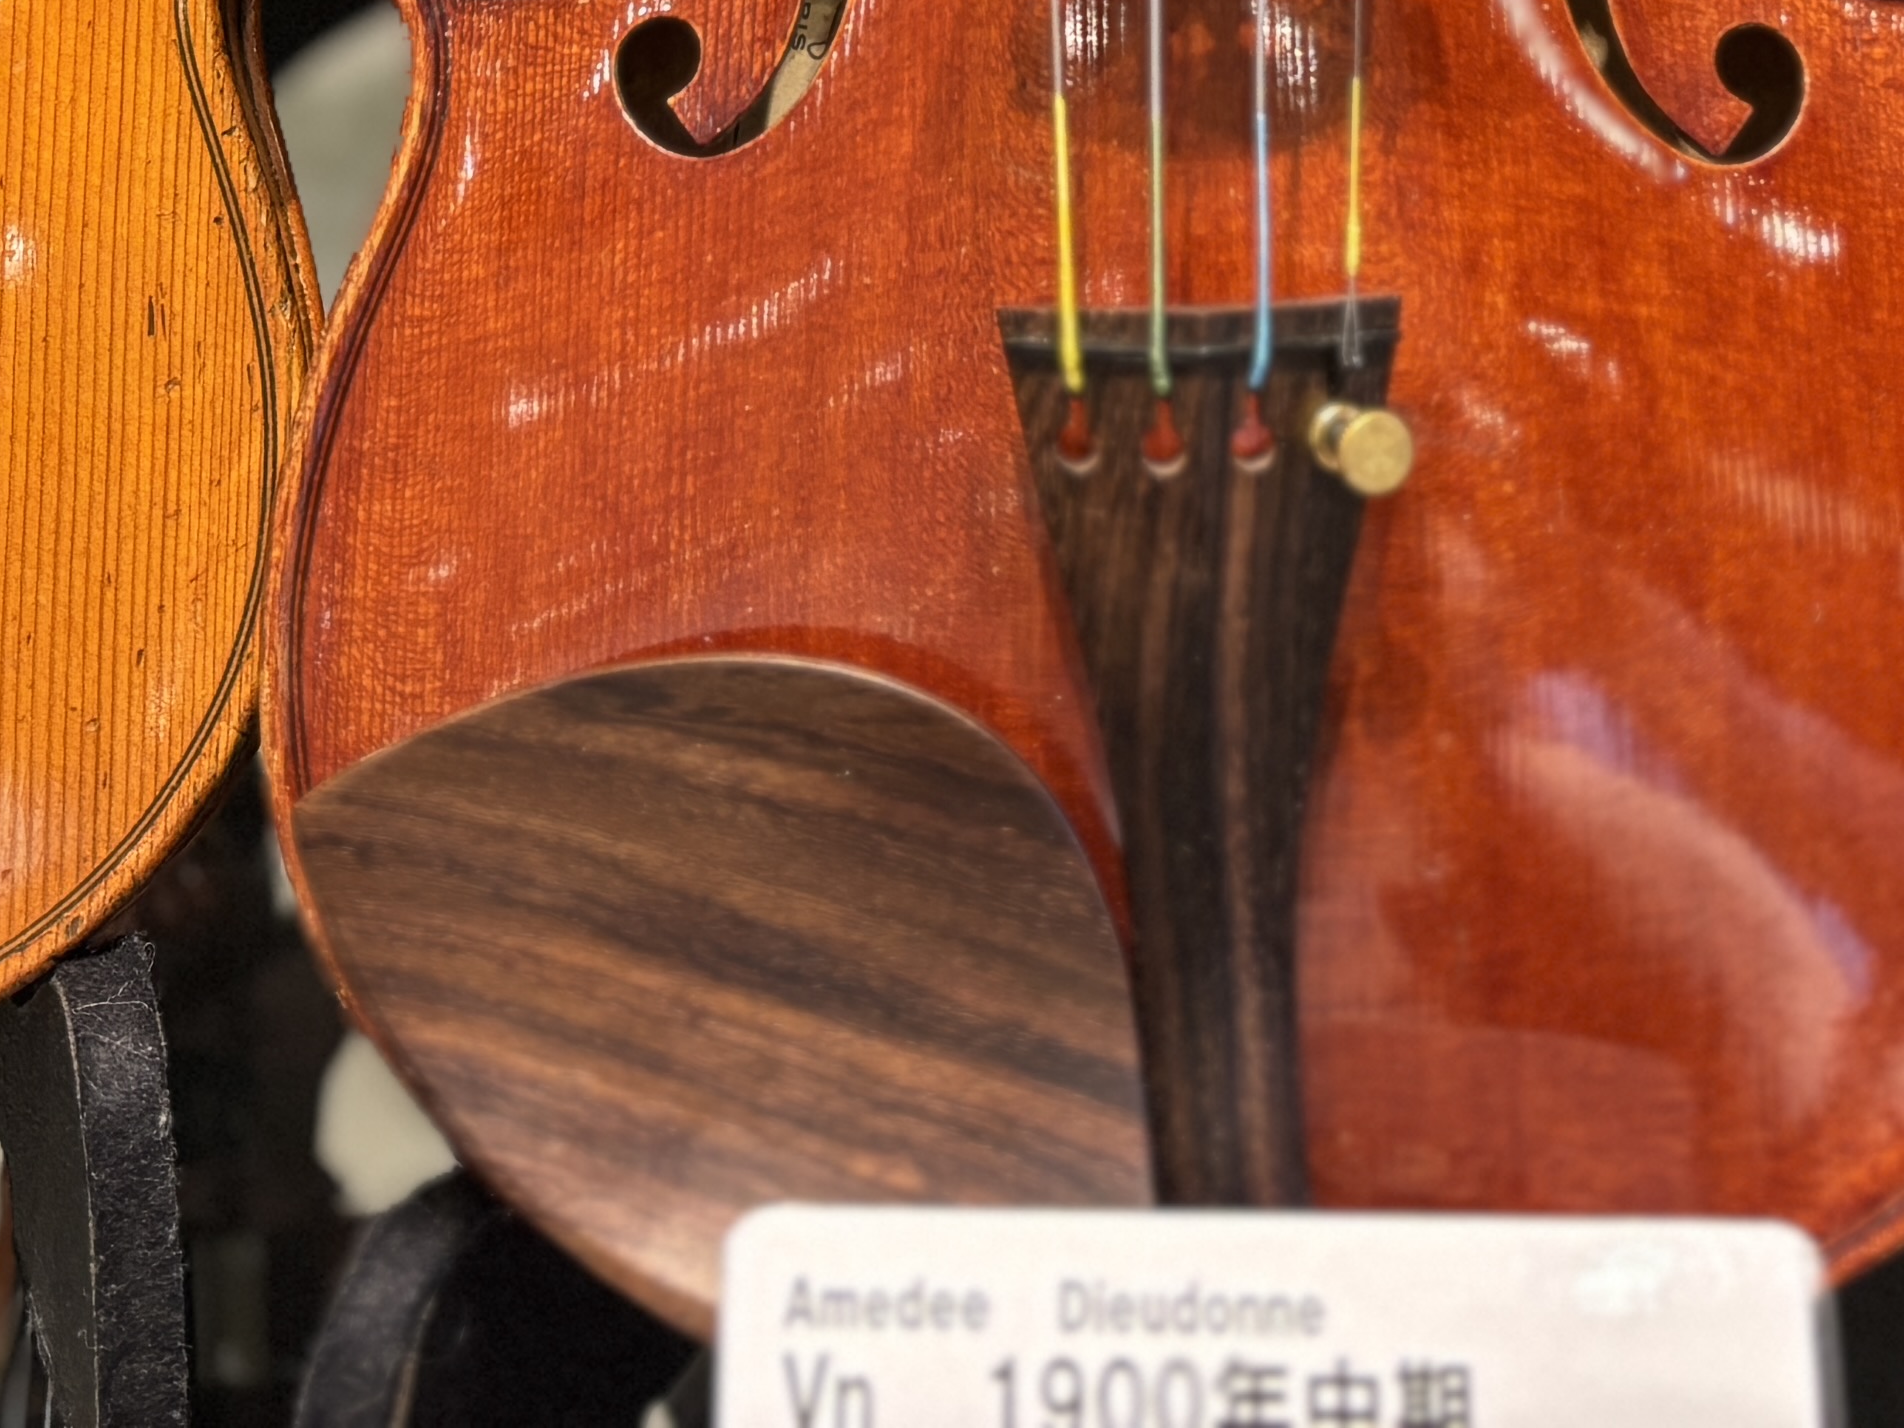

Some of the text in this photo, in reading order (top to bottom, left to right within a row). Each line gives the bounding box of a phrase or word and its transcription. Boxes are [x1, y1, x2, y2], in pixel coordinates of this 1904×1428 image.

[783, 1276, 1326, 1338] Amedee Dieudonne
[782, 1351, 875, 1428] Vn
